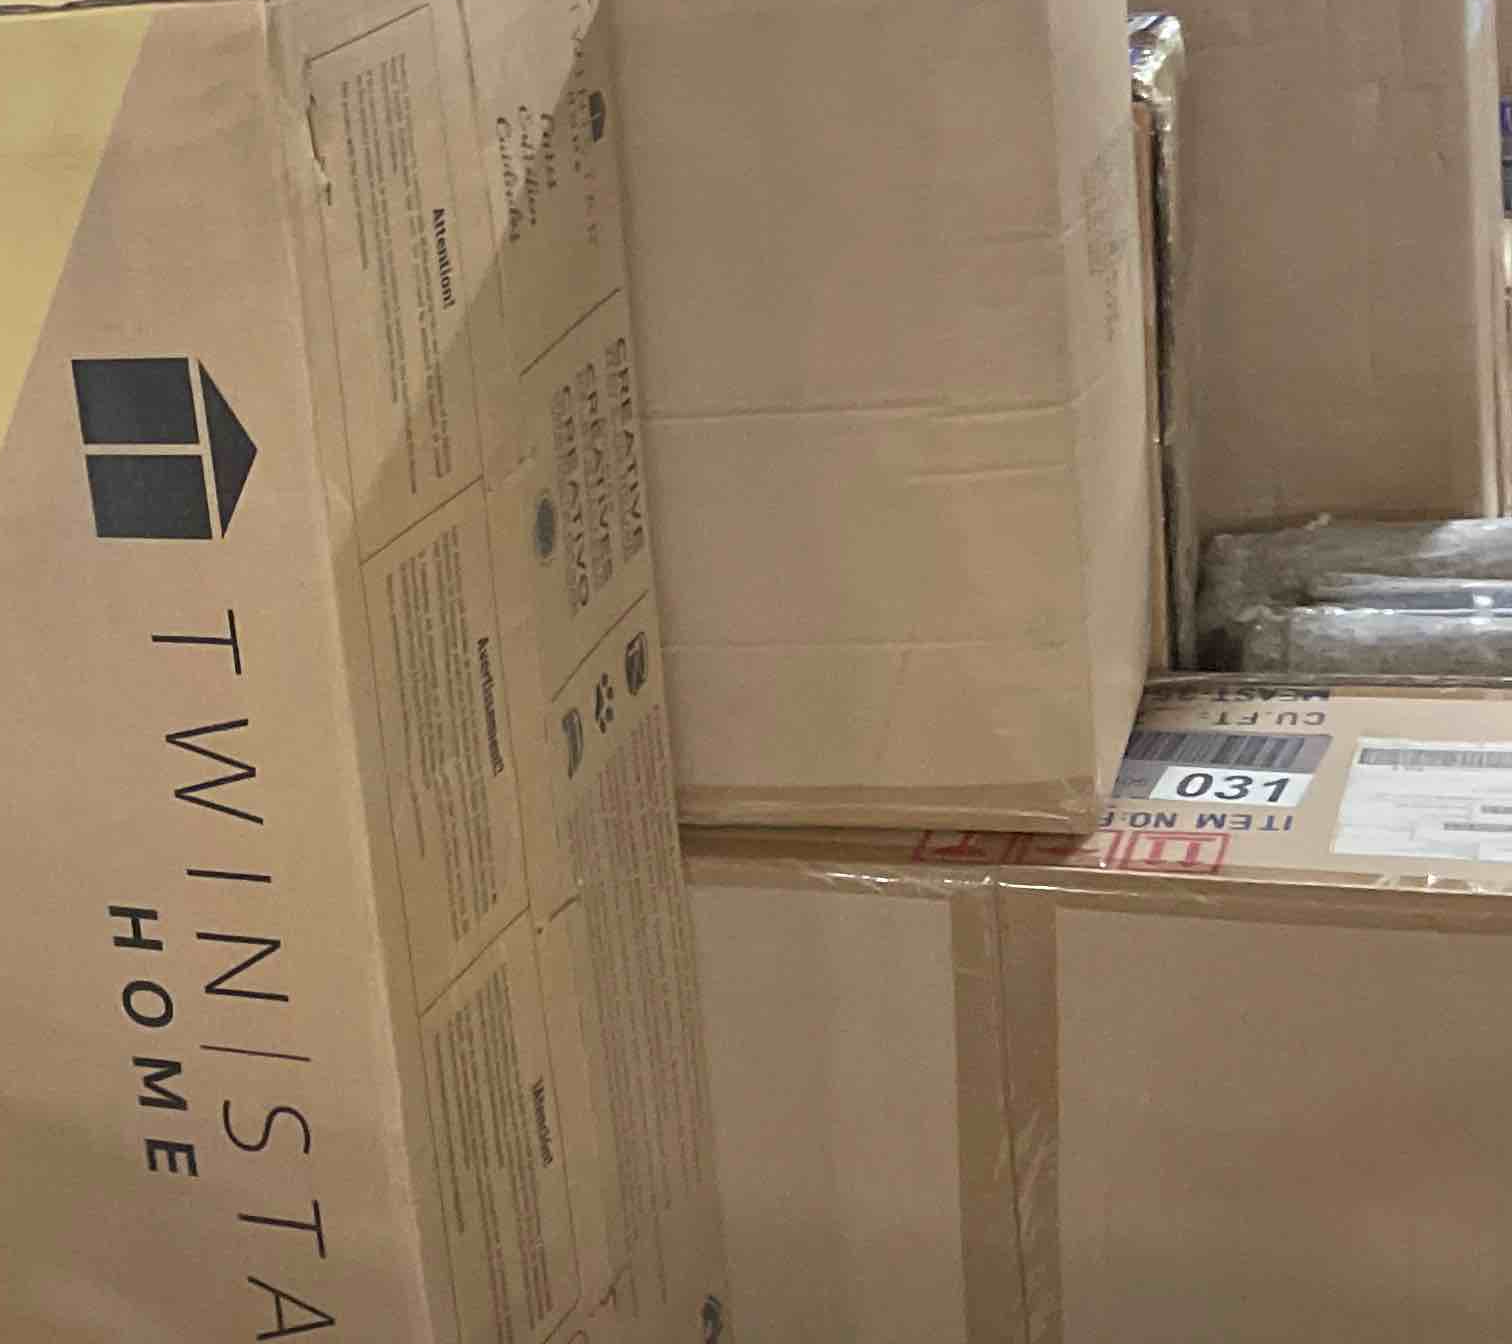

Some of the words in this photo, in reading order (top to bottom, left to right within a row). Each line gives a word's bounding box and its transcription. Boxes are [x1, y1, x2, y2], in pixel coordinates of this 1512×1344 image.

[429, 205, 458, 311] Attention!
[1176, 772, 1290, 803] 031
[1195, 812, 1294, 832] ITEM
[107, 905, 200, 1179] HOME
